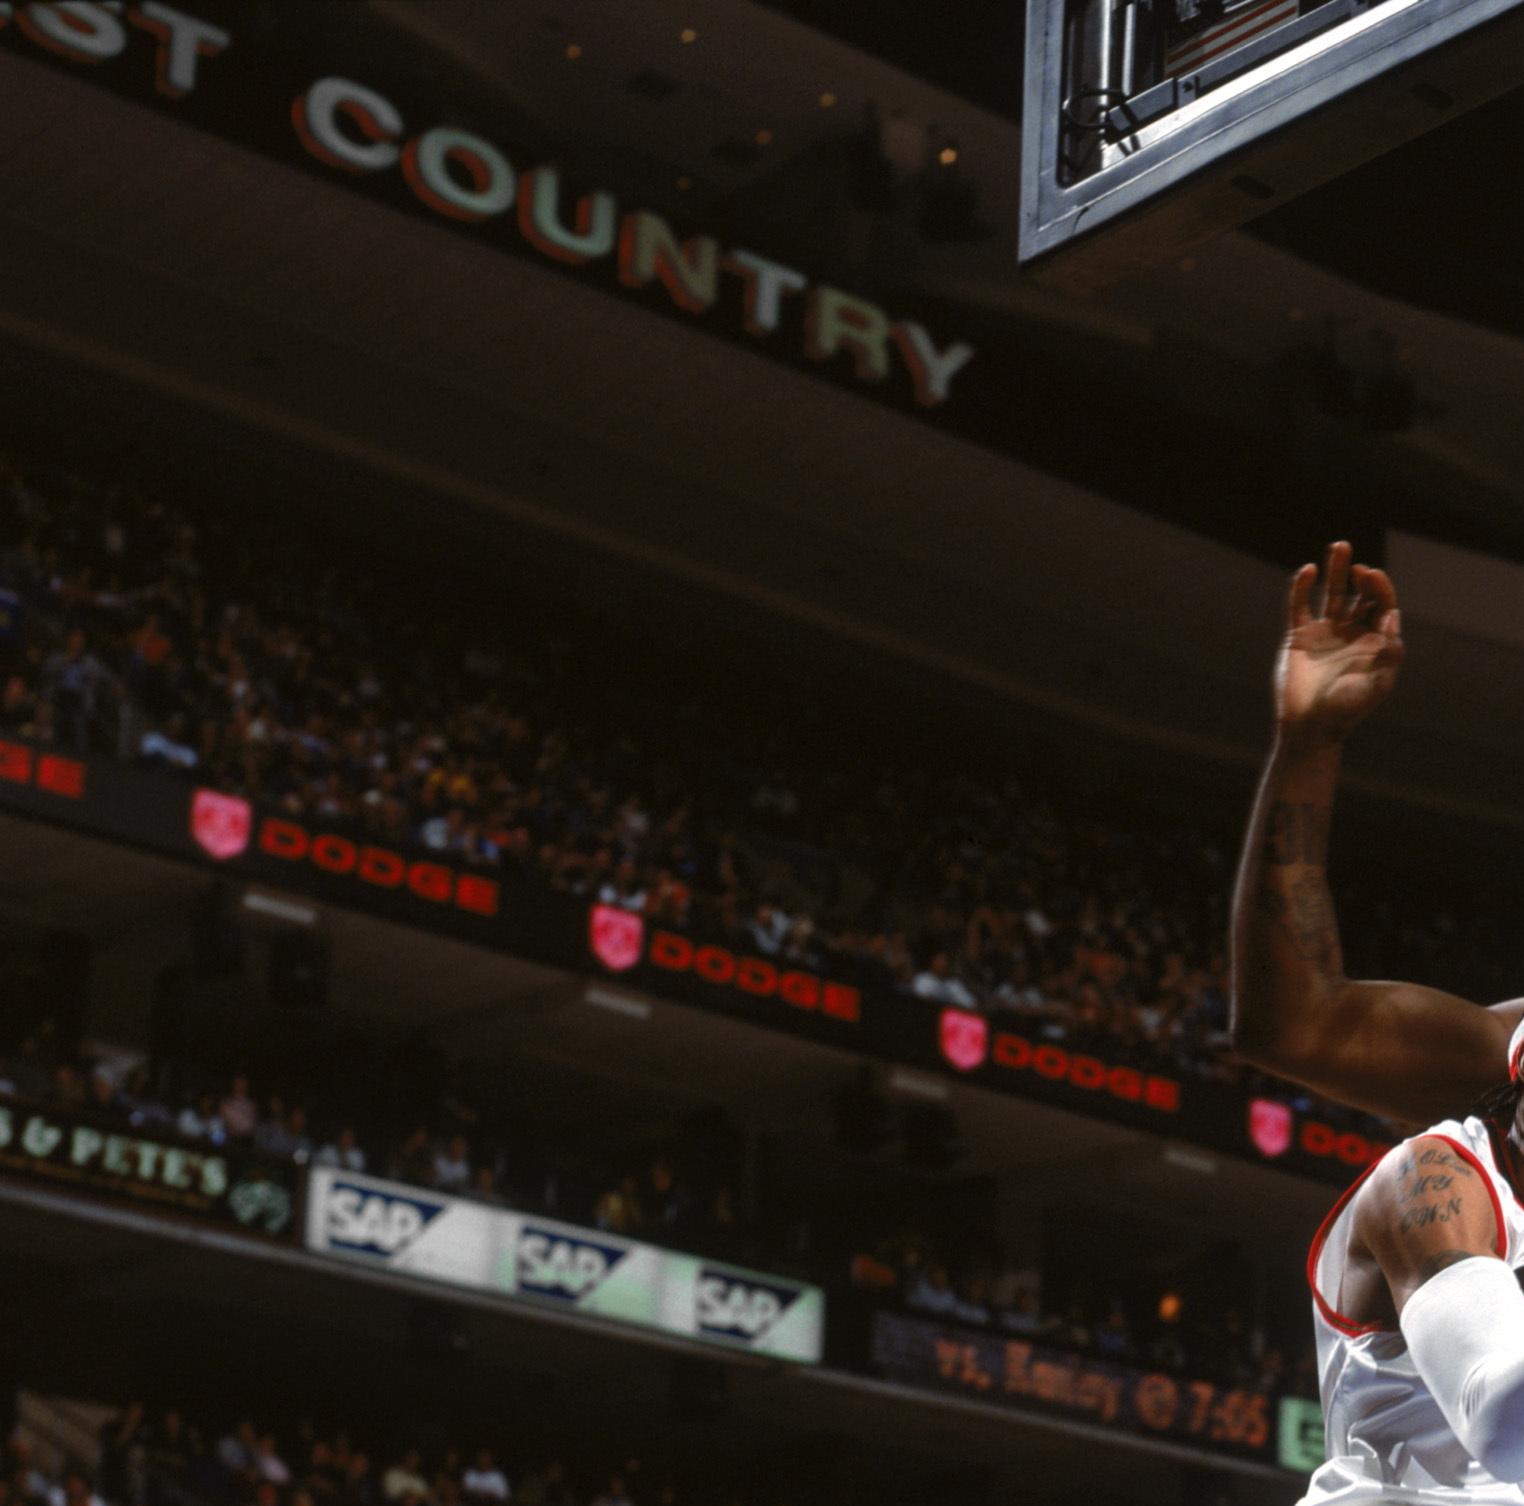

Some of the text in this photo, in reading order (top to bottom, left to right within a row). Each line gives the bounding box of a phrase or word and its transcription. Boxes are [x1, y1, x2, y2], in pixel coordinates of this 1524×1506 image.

[295, 77, 973, 402] COUNTRY
[259, 819, 497, 916] DODGE
[650, 932, 858, 1021] DODGE
[993, 1034, 1178, 1111] DODGE
[326, 1187, 422, 1255] SAP
[516, 1228, 607, 1298] SAP
[698, 1270, 783, 1338] SAP
